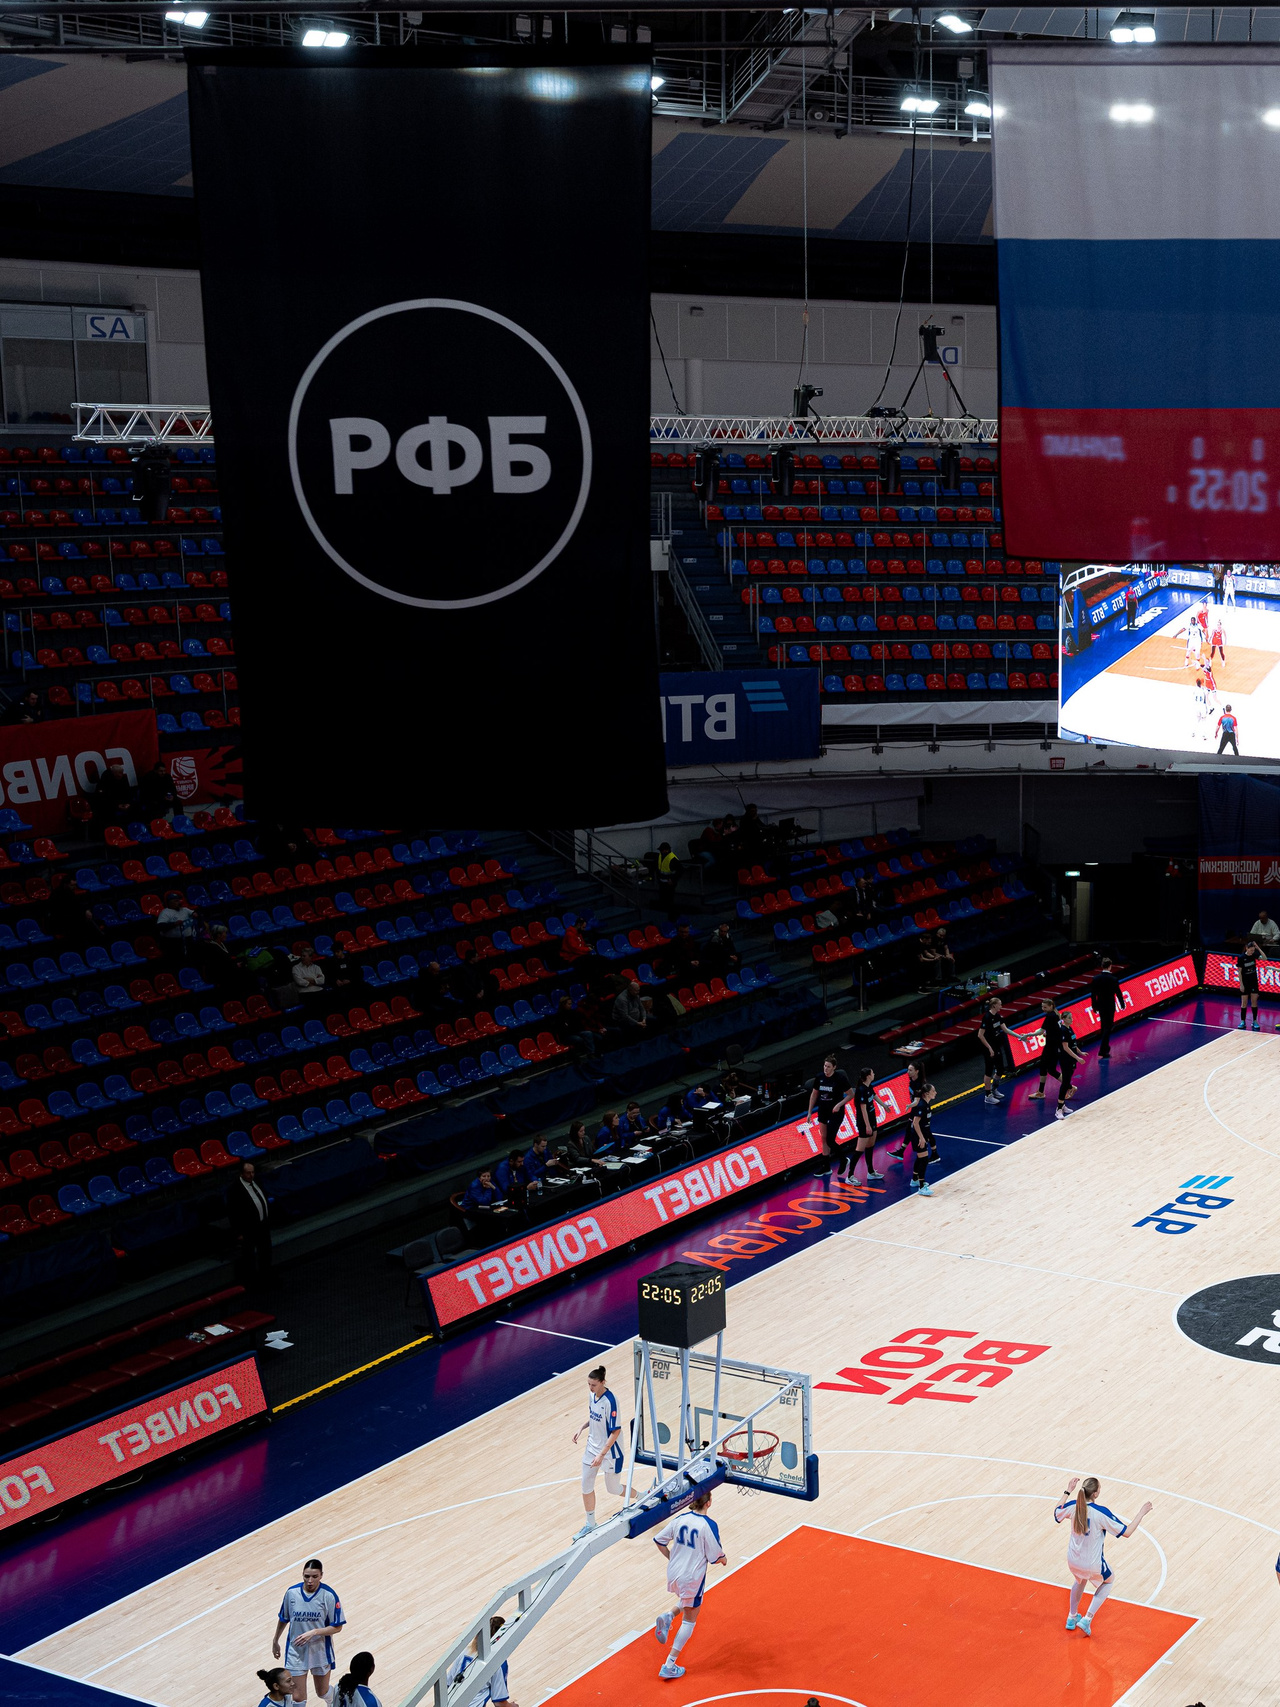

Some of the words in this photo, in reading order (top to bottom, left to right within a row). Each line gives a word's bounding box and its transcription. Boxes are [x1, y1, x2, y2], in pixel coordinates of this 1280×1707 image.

[330, 417, 550, 494] РФБ
[652, 1362, 670, 1371] FON
[652, 1370, 670, 1379] BET
[779, 1397, 798, 1406] BET
